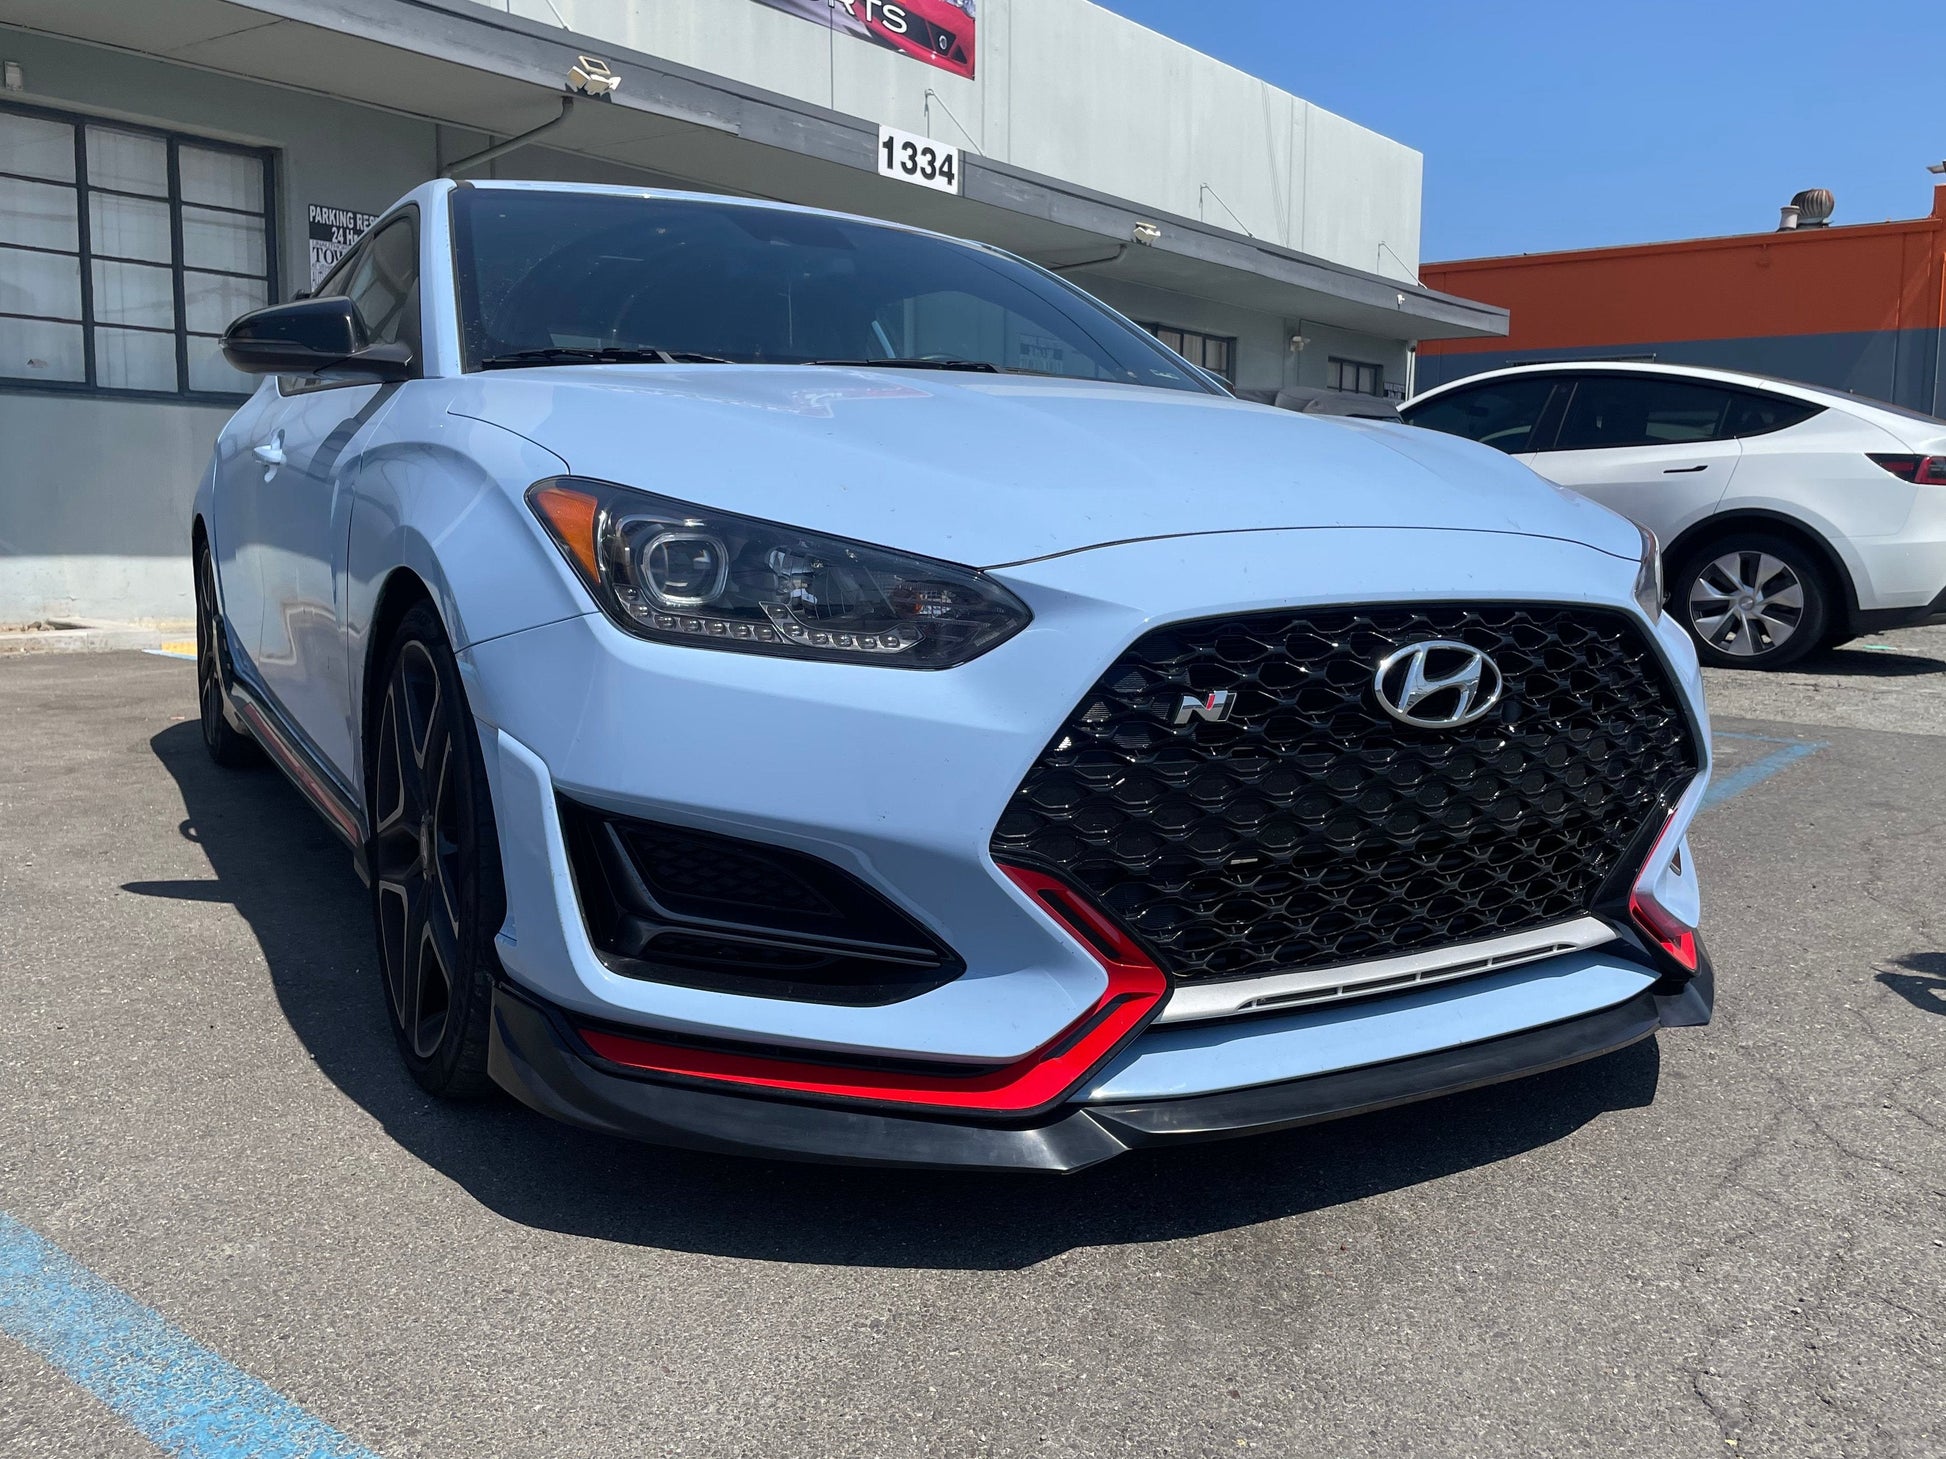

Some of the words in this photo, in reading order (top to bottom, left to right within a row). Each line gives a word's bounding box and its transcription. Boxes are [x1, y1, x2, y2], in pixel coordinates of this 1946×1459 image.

[882, 136, 955, 186] 1334
[309, 205, 354, 229] PARKING
[356, 213, 379, 231] RES
[331, 226, 344, 244] 24
